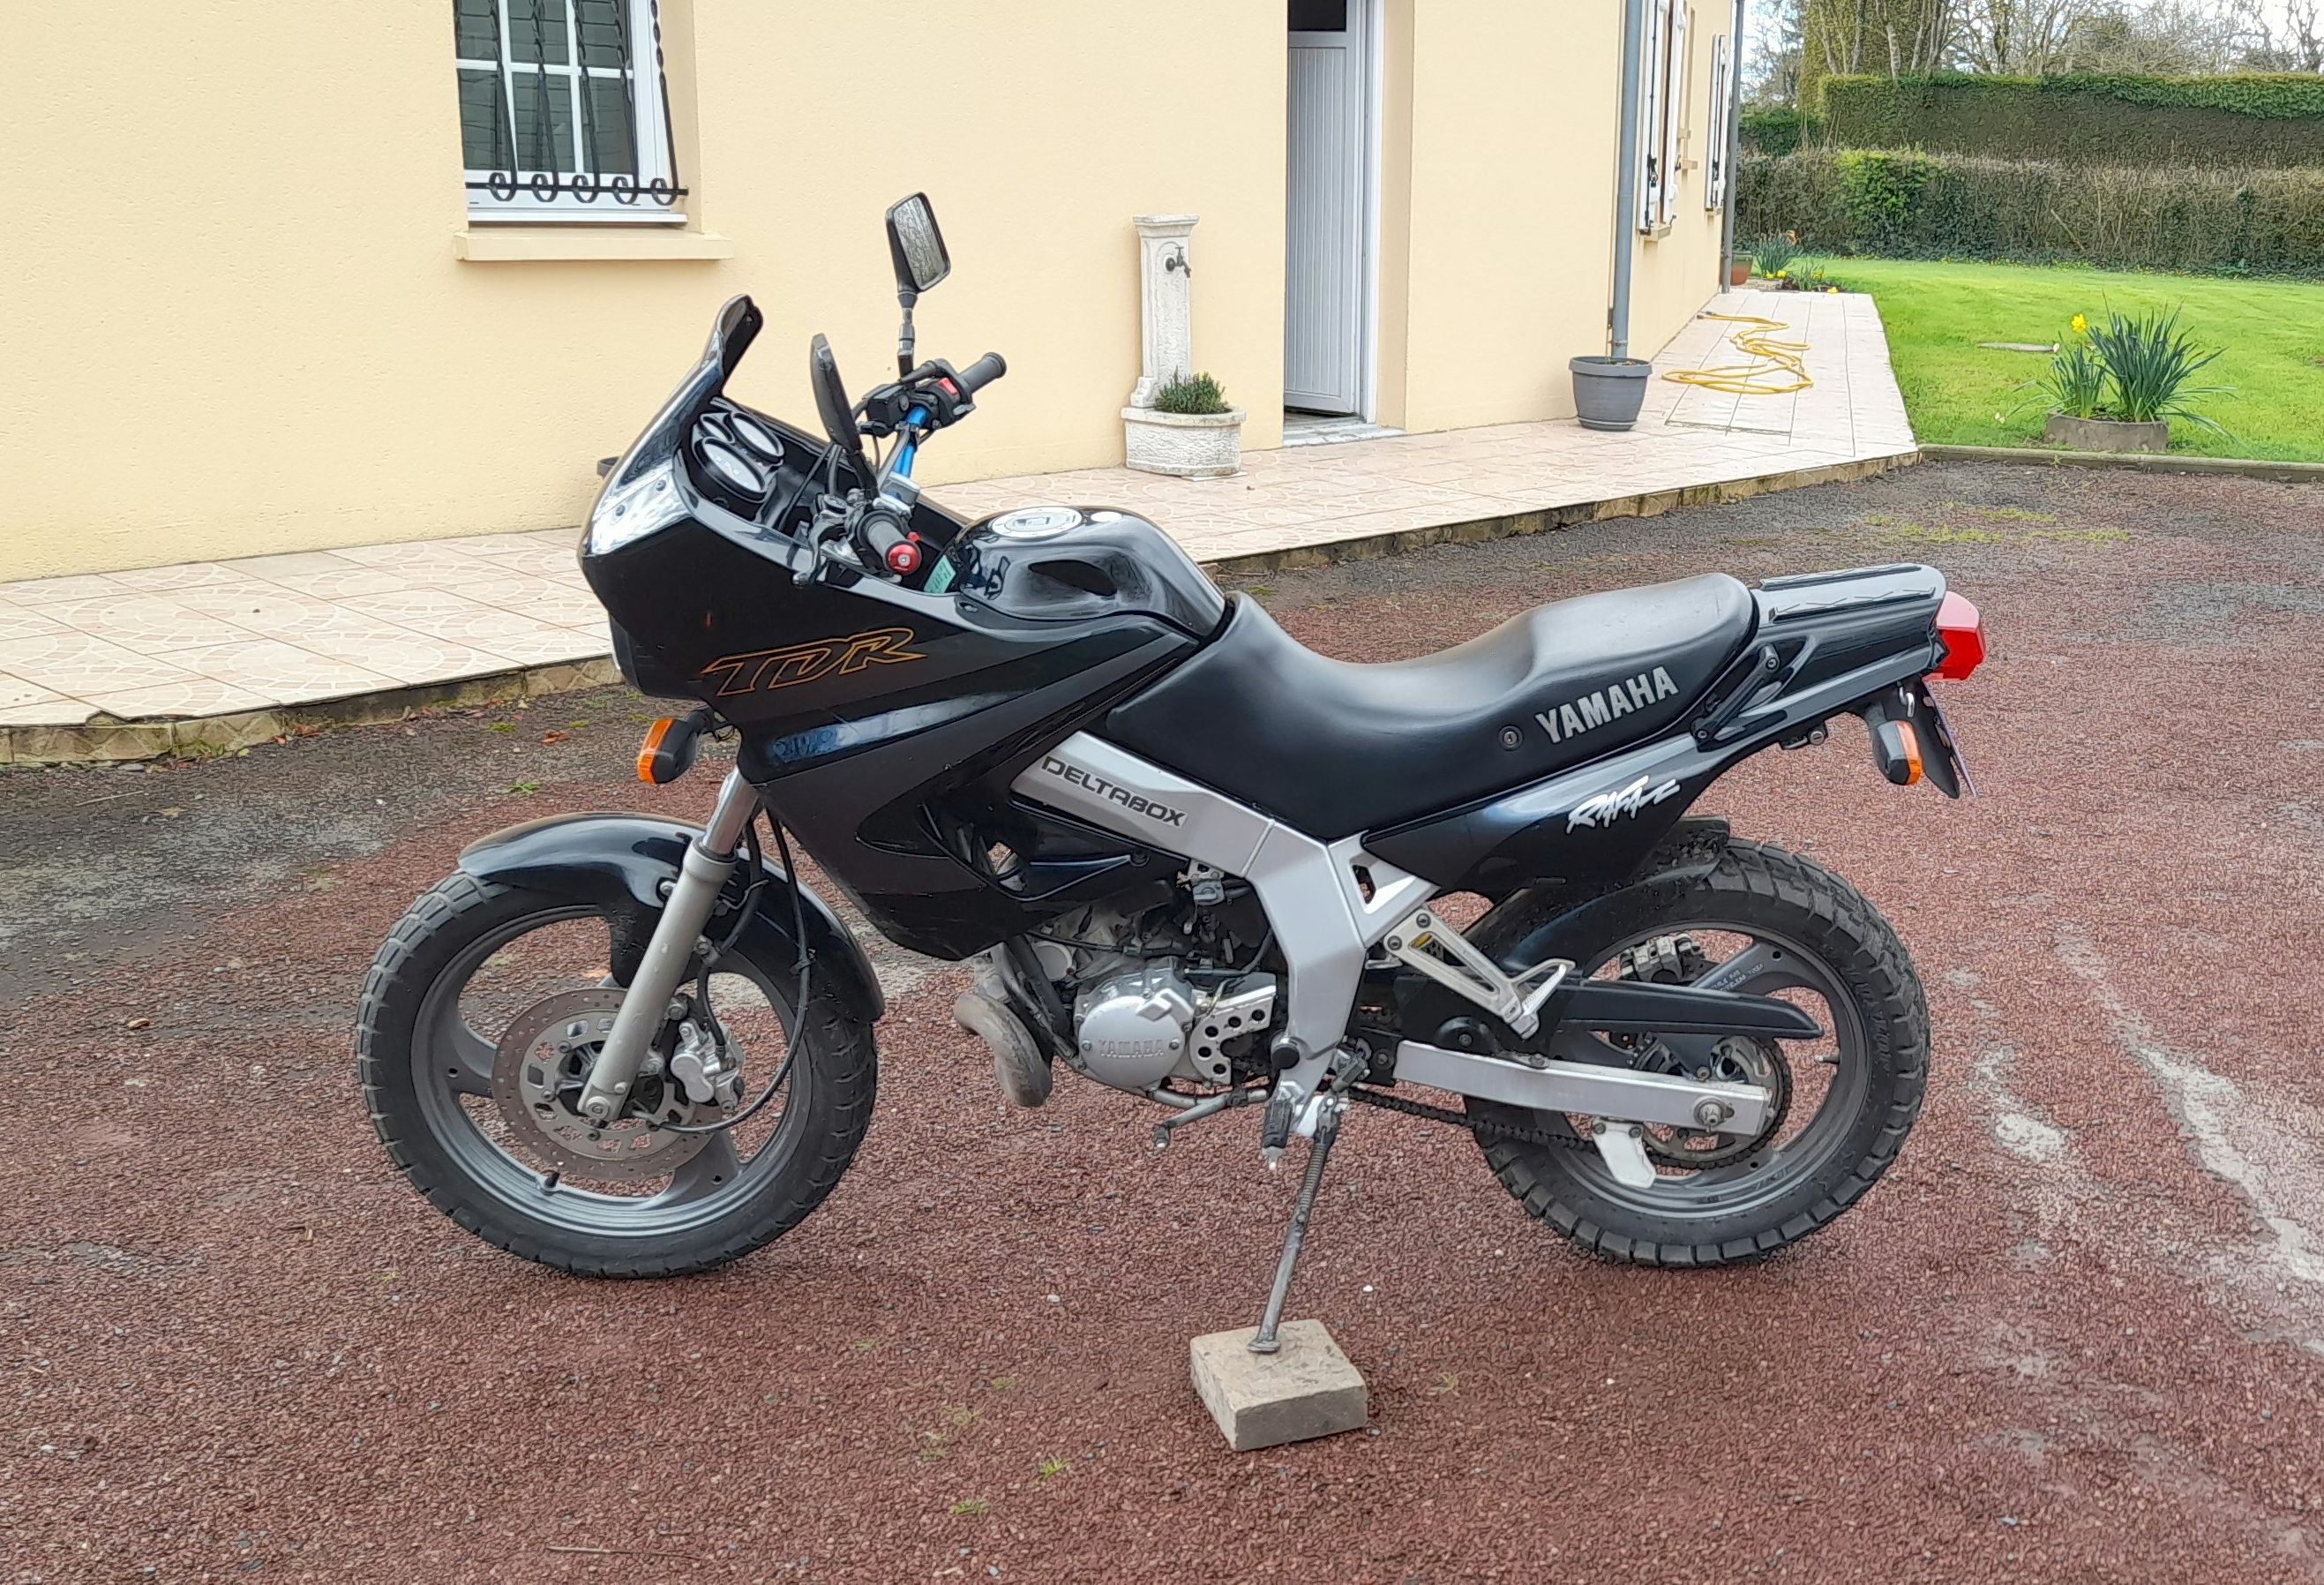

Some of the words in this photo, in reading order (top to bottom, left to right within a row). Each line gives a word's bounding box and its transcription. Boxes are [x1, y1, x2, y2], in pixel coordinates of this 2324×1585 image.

[701, 627, 927, 696] TDR
[1535, 666, 1679, 743] YAMAHA
[1041, 755, 1186, 827] DELTABOX
[1098, 1039, 1165, 1059] YAMAHA
